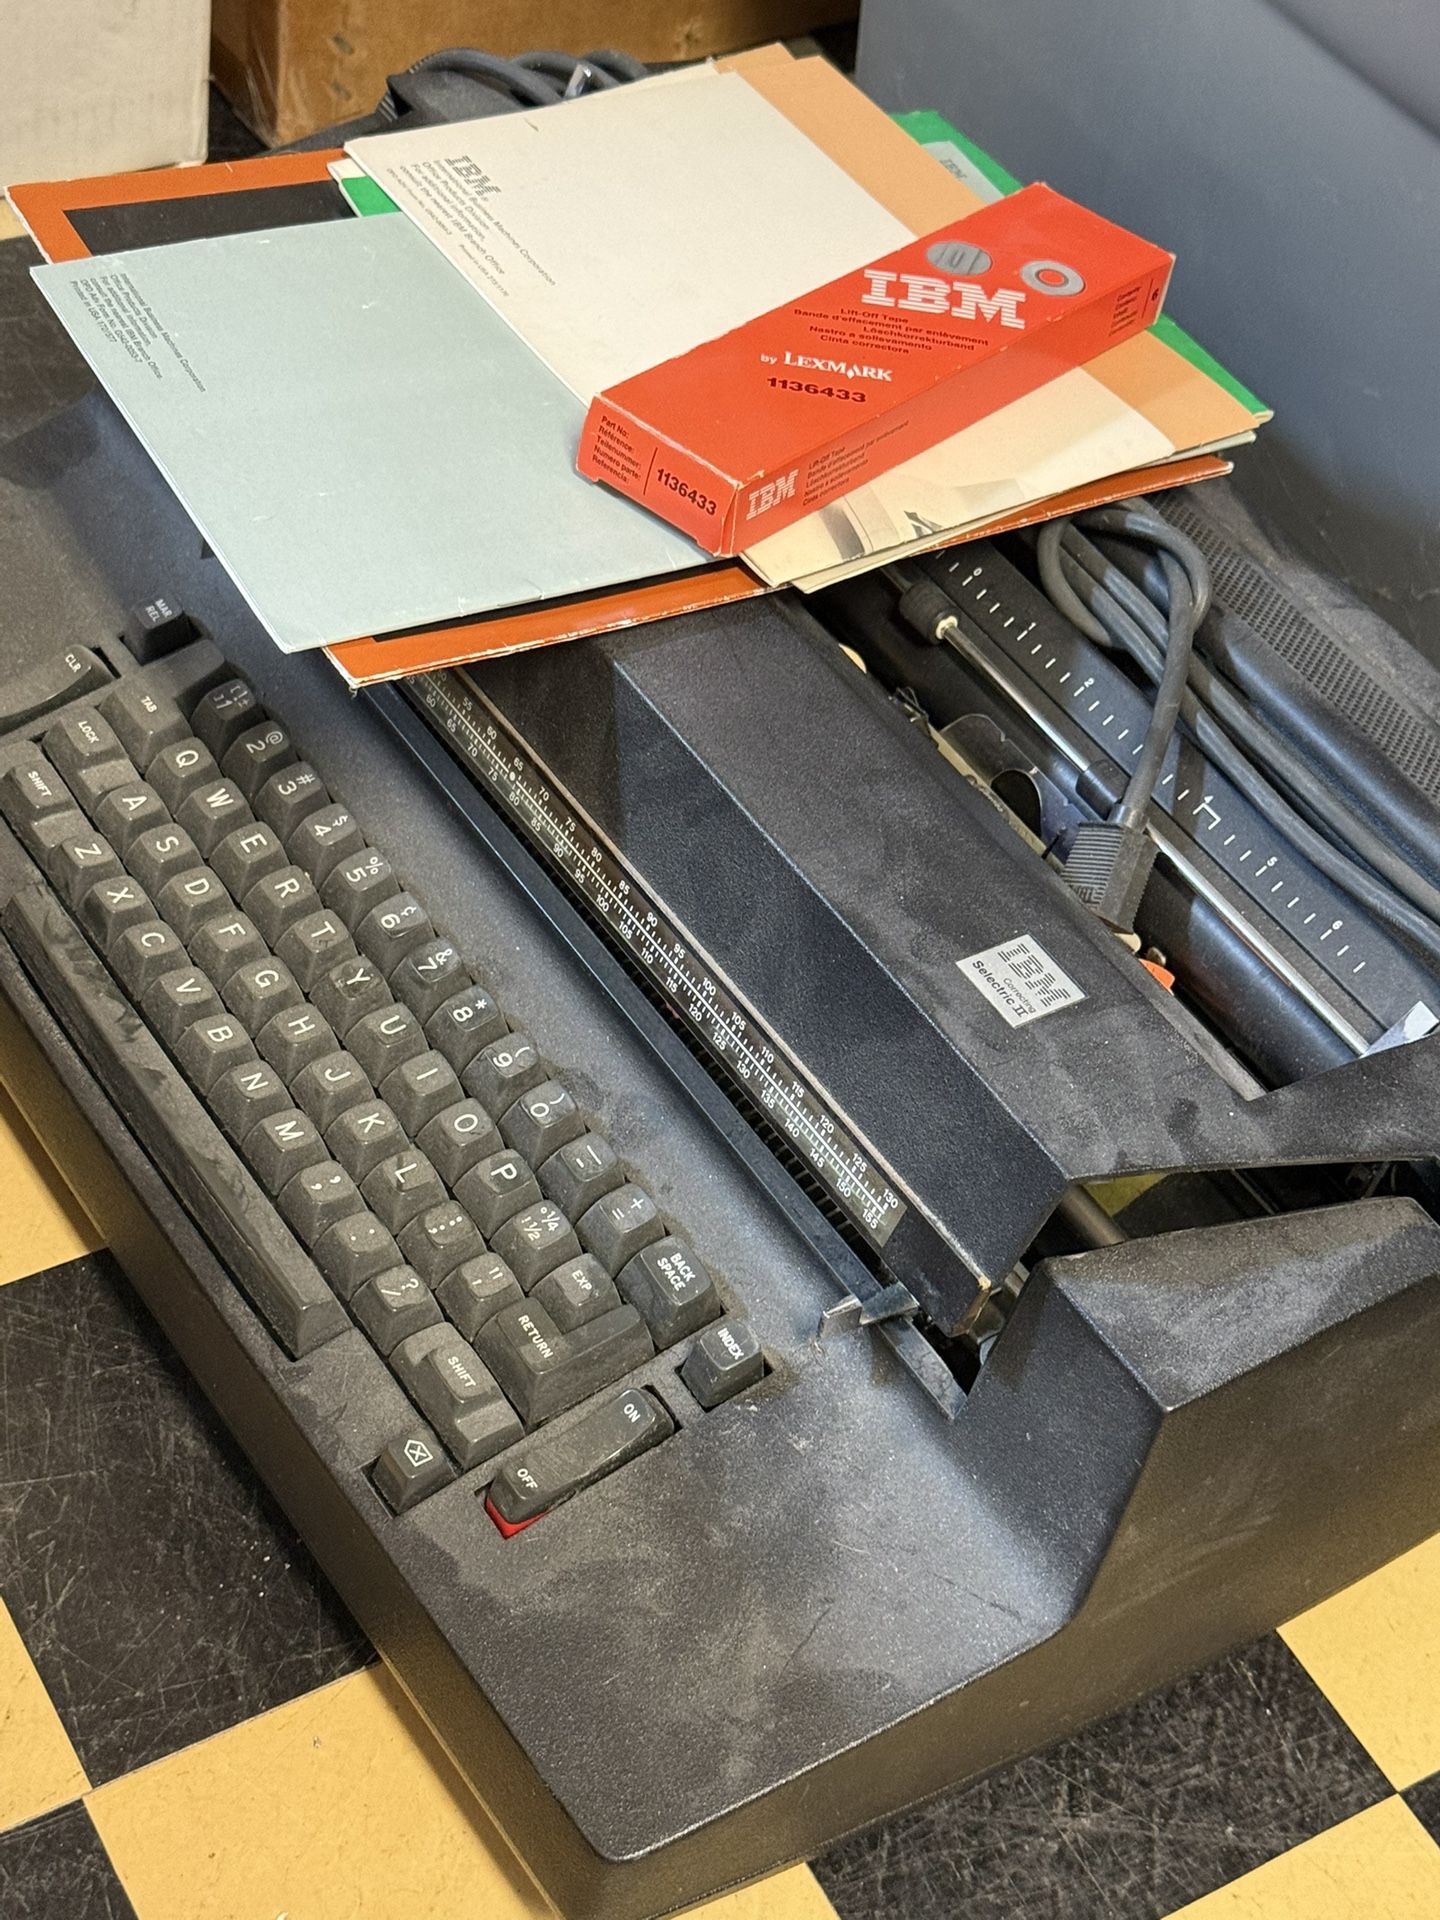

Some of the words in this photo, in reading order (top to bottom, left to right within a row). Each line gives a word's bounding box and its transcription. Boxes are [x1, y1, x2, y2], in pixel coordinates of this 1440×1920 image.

[445, 156, 502, 196] IBM
[422, 162, 443, 179] Office
[439, 180, 468, 205] Products
[464, 206, 492, 229] Division
[450, 219, 467, 232] IBM
[483, 255, 507, 274] Office
[469, 197, 496, 221] Business
[492, 221, 522, 248] Machines
[517, 248, 558, 285] Corporation
[110, 274, 125, 290] Office
[122, 292, 142, 315] Products
[139, 317, 158, 338] Division
[861, 269, 1026, 330] IBM
[794, 309, 830, 319] Bande
[832, 314, 902, 331] d'effacement
[840, 308, 880, 319] Lift-Off
[882, 314, 909, 324] Tape
[810, 325, 846, 337] Nastro
[125, 329, 136, 339] IBM
[148, 362, 163, 378] Office
[144, 307, 164, 330] Business
[161, 332, 183, 358] Machines
[179, 359, 207, 391] Corporation
[820, 334, 848, 344] Cinta
[852, 340, 910, 354] correctora
[760, 352, 777, 364] by
[784, 351, 893, 382] LEXMARK
[767, 377, 866, 403] 1136433
[601, 416, 616, 429] Part
[832, 447, 846, 459] Tape
[657, 468, 717, 516] 1136433
[746, 468, 800, 520] IBM
[146, 606, 160, 622] REL
[155, 598, 172, 618] MAR
[65, 654, 82, 673] CLR
[1084, 678, 1094, 688] 2
[140, 696, 158, 713] TAB
[78, 720, 100, 744] LOCK
[176, 750, 198, 768] Q
[28, 770, 52, 798] SHIFT
[122, 796, 148, 810] A
[206, 788, 234, 808] W
[74, 843, 102, 860] Z
[156, 836, 179, 852] S
[240, 834, 268, 854] E
[1267, 856, 1278, 867] 5
[106, 887, 134, 904] X
[184, 878, 210, 895] D
[274, 878, 300, 898] R
[218, 922, 246, 936] F
[311, 920, 336, 937] T
[1332, 920, 1343, 930] 6
[141, 932, 165, 947] C
[462, 698, 472, 711] 55
[487, 726, 496, 740] 60
[514, 757, 524, 771] 65
[539, 786, 550, 800] 70
[566, 817, 576, 832] 75
[591, 847, 602, 862] 80
[619, 880, 630, 895] 85
[646, 912, 658, 927] 90
[674, 943, 686, 958] 95
[702, 977, 716, 996] 100
[732, 1012, 746, 1030] 105
[762, 1046, 774, 1064] 110
[792, 1080, 804, 1098] 115
[820, 1114, 834, 1134] 120
[852, 1152, 868, 1172] 125
[882, 1188, 898, 1208] 130
[176, 978, 201, 992] V
[254, 970, 279, 988] G
[346, 968, 370, 985] Y
[998, 944, 1071, 1007] IBM
[972, 960, 1015, 1006] Selectric
[1013, 1004, 1028, 1017] II
[1003, 977, 1036, 1014] Correcting
[207, 1025, 233, 1042] B
[288, 1016, 316, 1036] H
[380, 1016, 406, 1034] U
[554, 844, 564, 858] 90
[574, 868, 585, 884] 95
[596, 894, 610, 912] 100
[618, 921, 632, 940] 105
[641, 948, 654, 964] 110
[666, 976, 678, 993] 115
[688, 1004, 702, 1022] 120
[712, 1032, 726, 1050] 125
[736, 1061, 750, 1079] 130
[760, 1090, 774, 1109] 135
[784, 1118, 800, 1138] 140
[809, 1148, 824, 1168] 145
[836, 1178, 850, 1198] 150
[862, 1208, 878, 1228] 155
[240, 1072, 268, 1090] N
[324, 1068, 350, 1082] J
[274, 1120, 304, 1141] M
[358, 1112, 385, 1133] K
[454, 1114, 478, 1132] O
[394, 1163, 417, 1183] L
[490, 1163, 517, 1180] P
[657, 1257, 686, 1292] SPACE
[670, 1252, 696, 1282] BACK
[572, 1269, 592, 1291] EXP
[518, 1314, 554, 1359] RETURN
[718, 1328, 744, 1360] INDEX
[448, 1356, 476, 1388] SHIFT
[624, 1403, 641, 1423] ON
[516, 1468, 538, 1488] OFF
